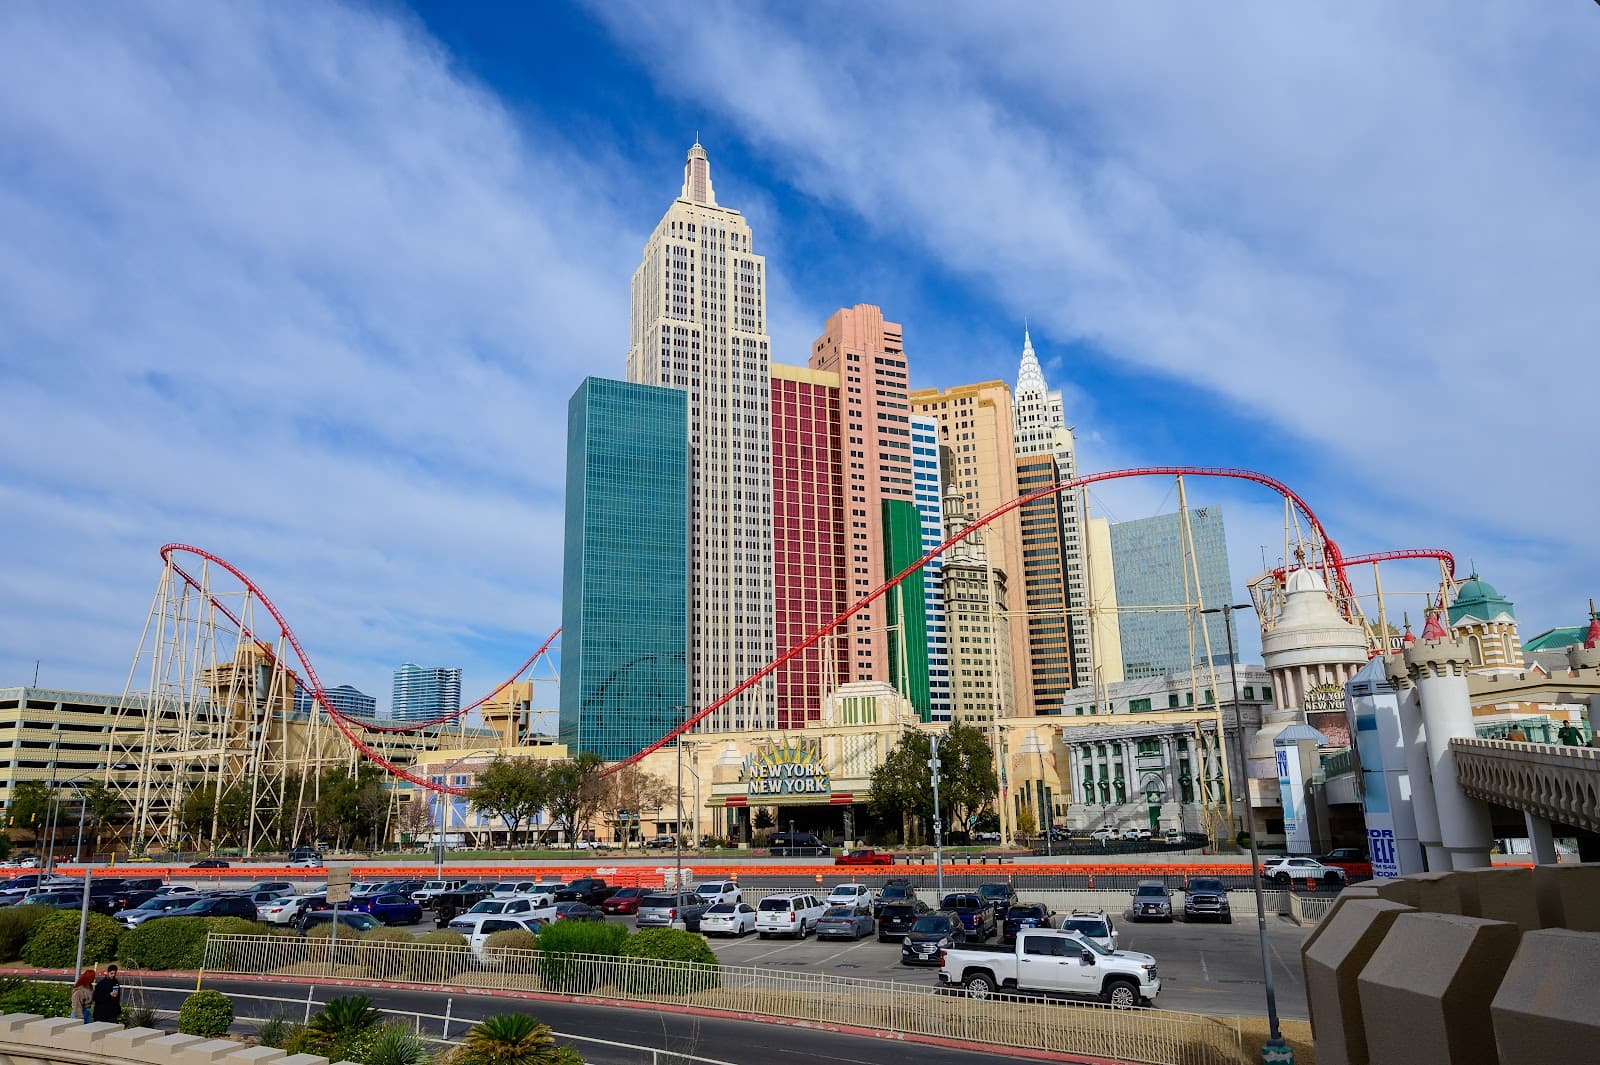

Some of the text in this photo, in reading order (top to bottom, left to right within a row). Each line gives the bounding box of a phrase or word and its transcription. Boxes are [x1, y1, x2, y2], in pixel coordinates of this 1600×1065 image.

[750, 763, 827, 778] NEW YORK
[750, 778, 827, 794] NEW YORK
